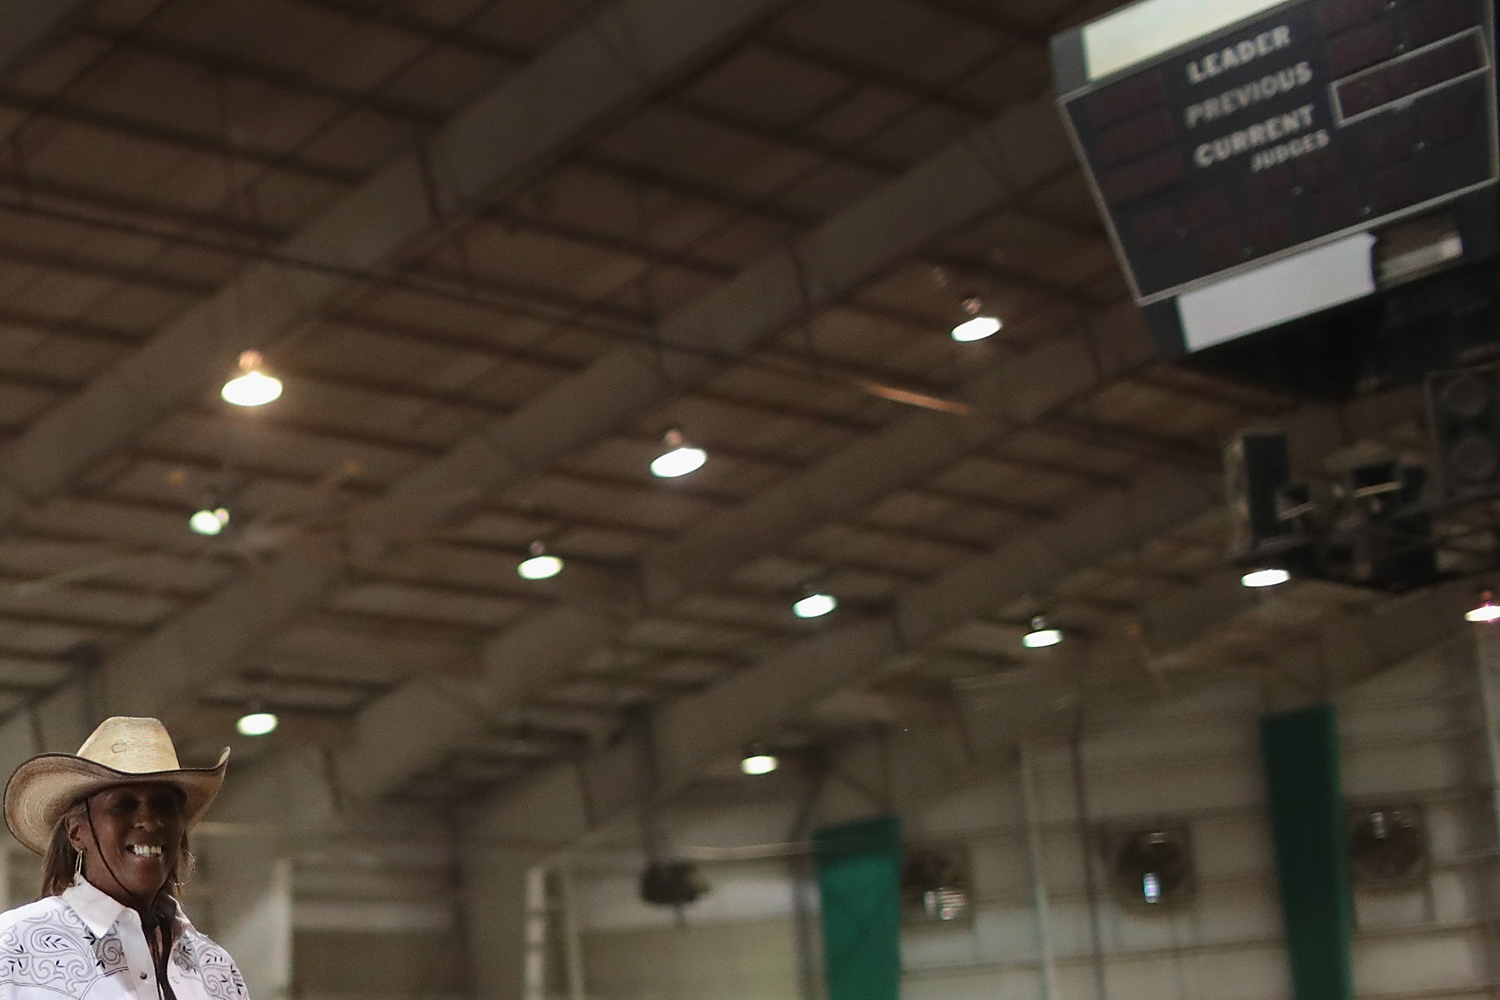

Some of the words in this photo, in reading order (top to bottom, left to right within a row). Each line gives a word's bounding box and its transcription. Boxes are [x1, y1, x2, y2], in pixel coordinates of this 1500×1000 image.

[1186, 25, 1291, 84] LEADER
[1184, 61, 1313, 128] PREVIOUS
[1193, 103, 1314, 168] CURRENT
[1251, 128, 1330, 172] JUDGES
